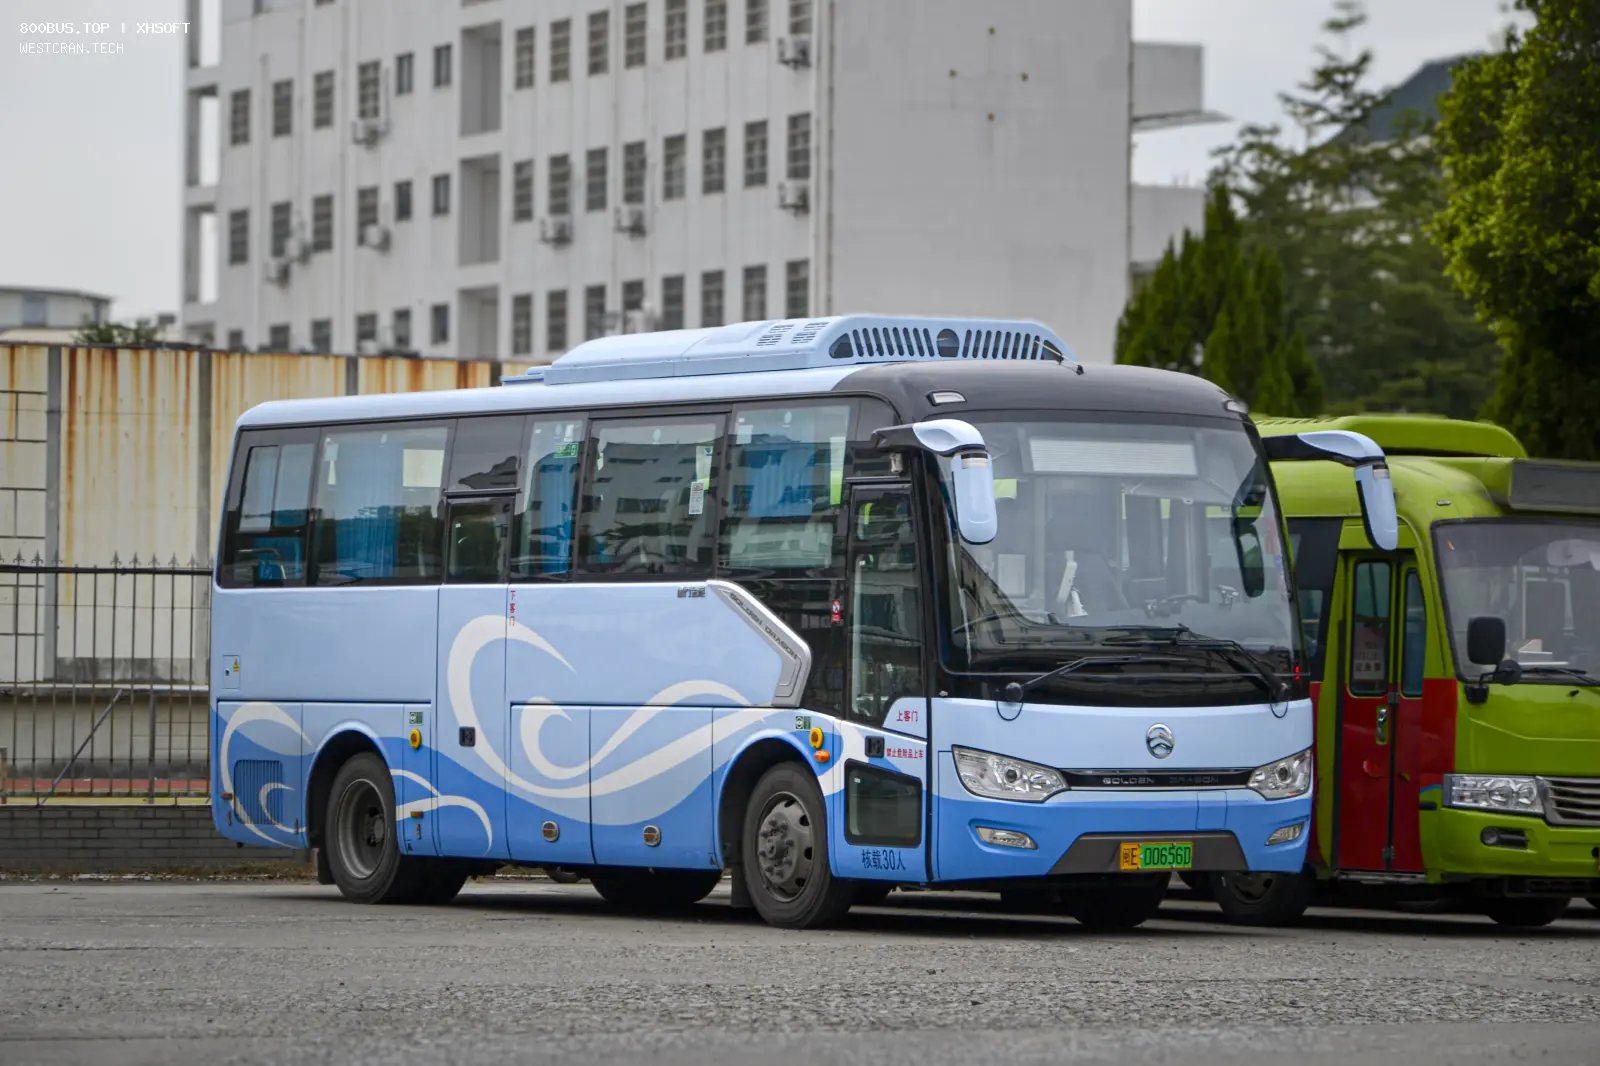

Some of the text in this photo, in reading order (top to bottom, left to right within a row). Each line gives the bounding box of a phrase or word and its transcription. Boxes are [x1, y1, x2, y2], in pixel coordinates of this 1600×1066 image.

[730, 593, 798, 660] GOLDEN DRAGON
[896, 709, 919, 722] 上客门
[1102, 776, 1155, 785] GOLDEN
[861, 849, 907, 871] 核载30人
